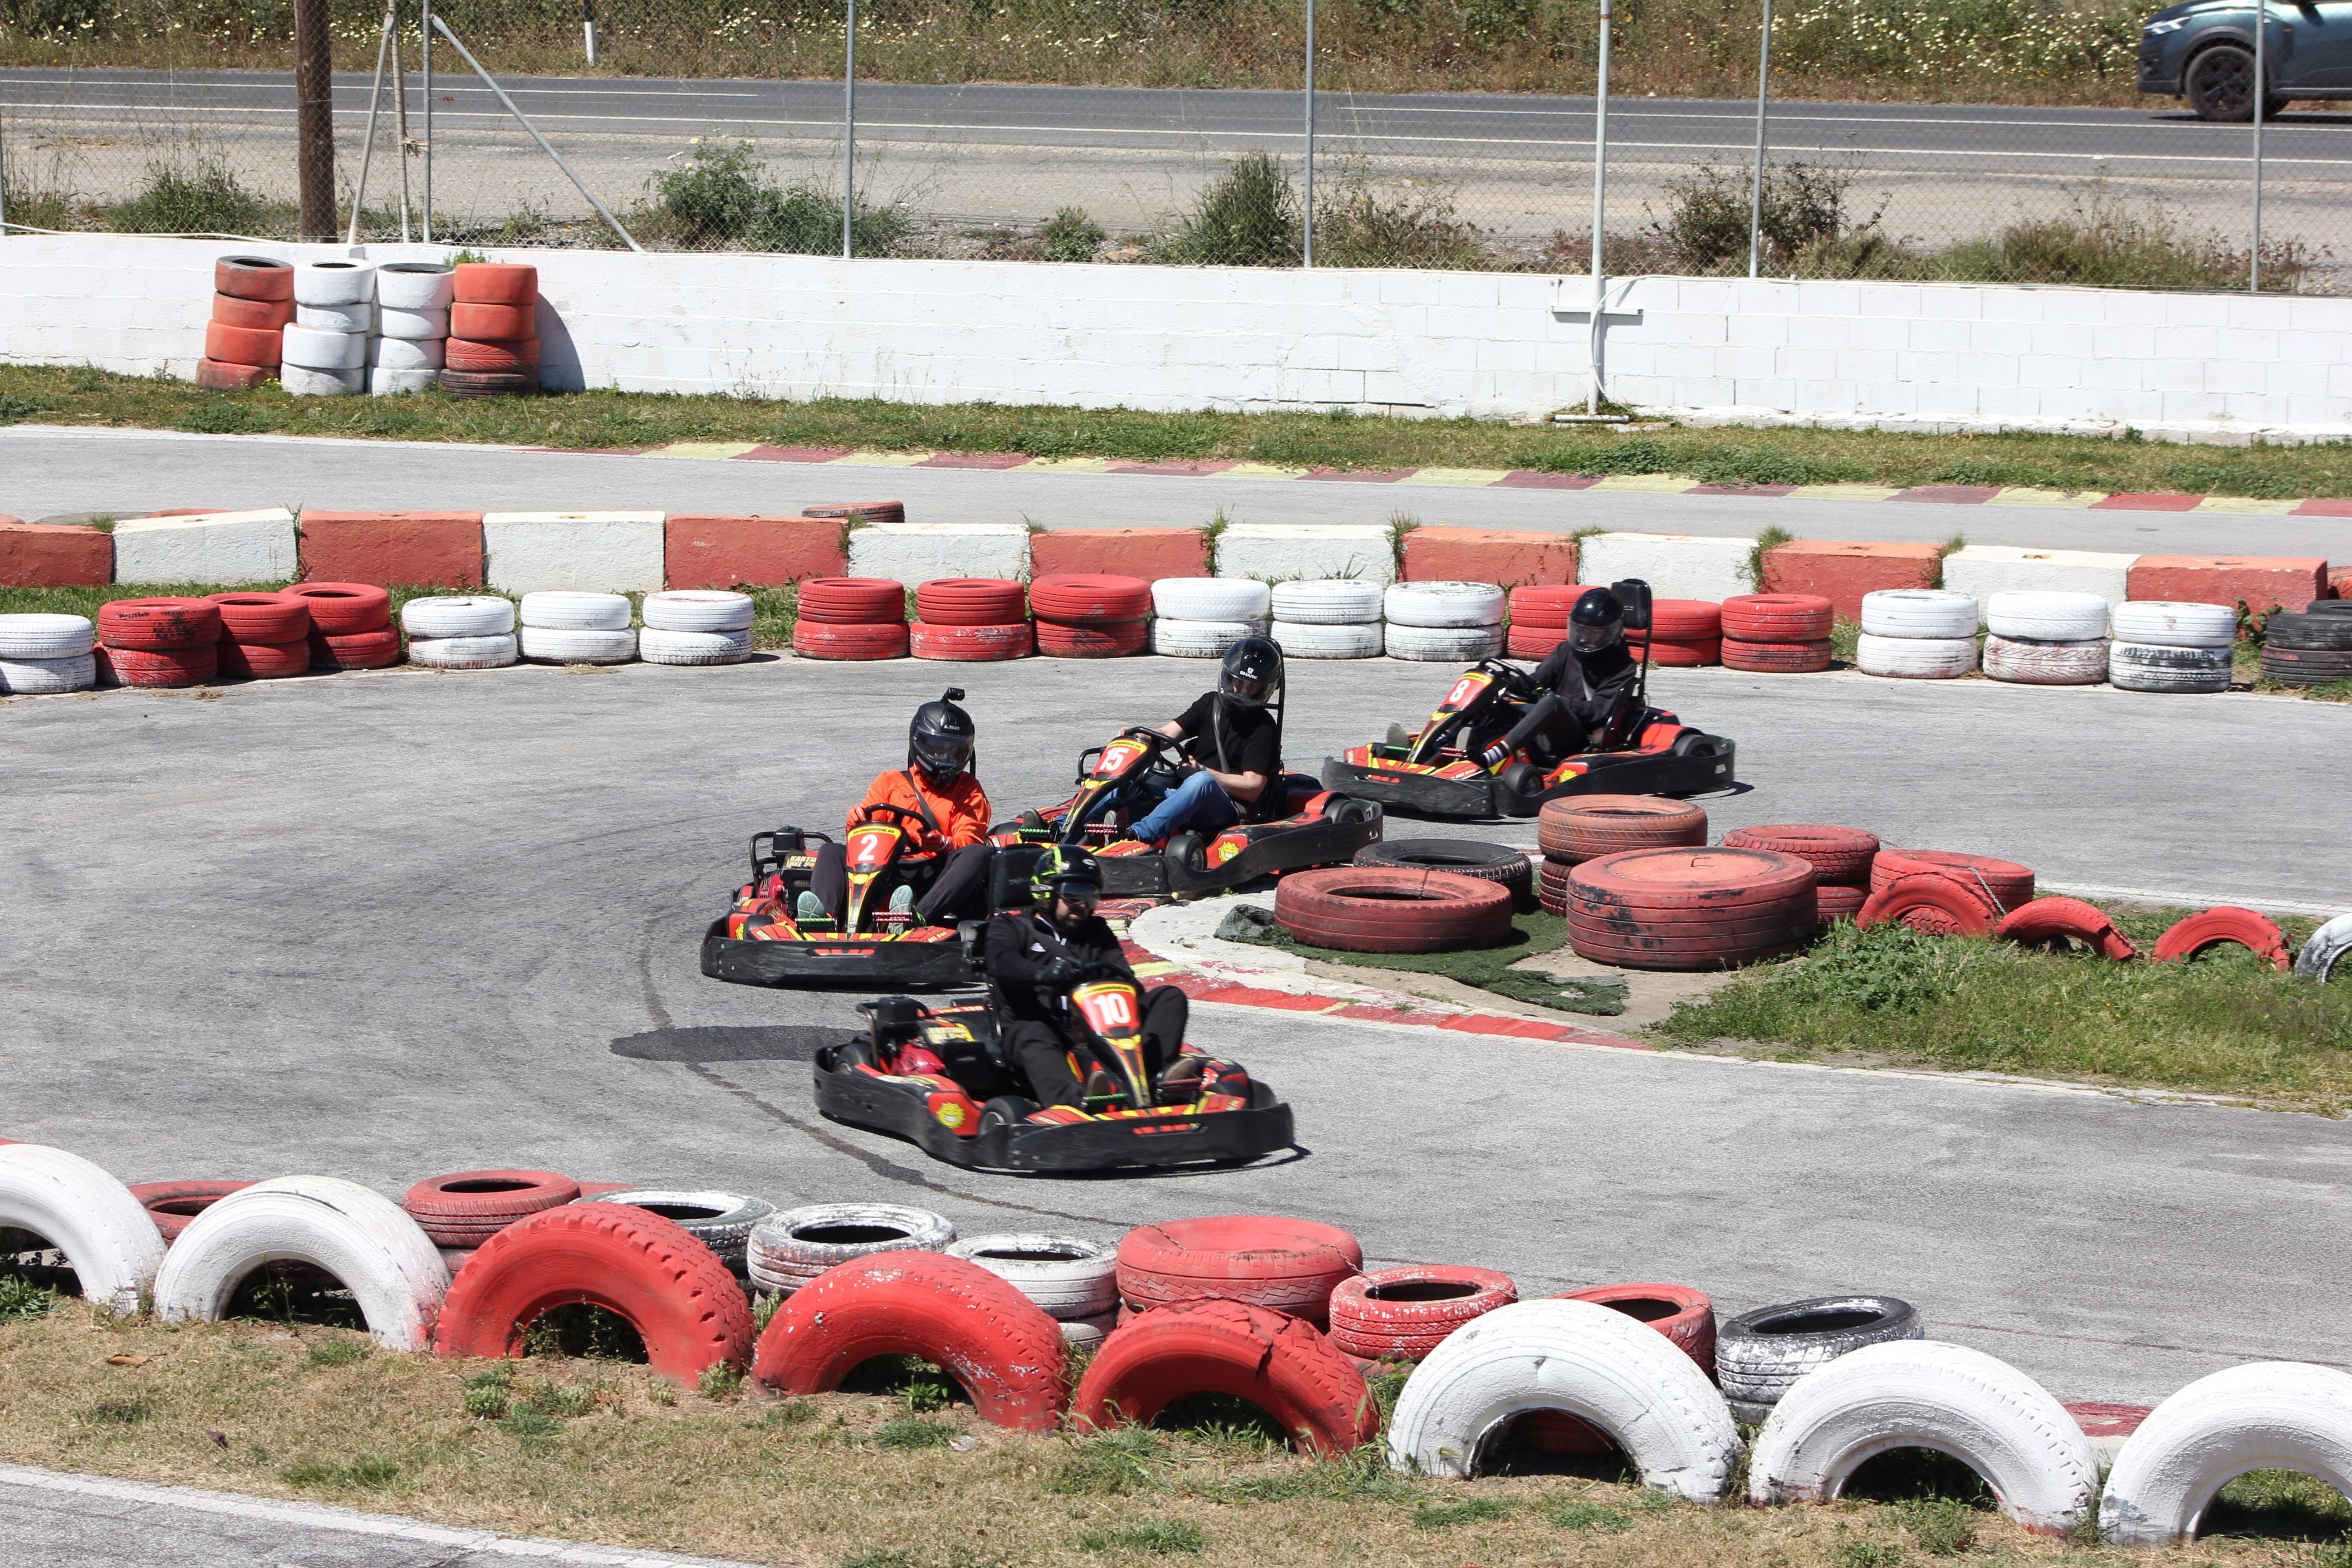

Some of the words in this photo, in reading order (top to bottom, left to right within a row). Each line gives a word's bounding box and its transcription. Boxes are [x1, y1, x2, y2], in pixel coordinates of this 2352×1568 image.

[1240, 671, 1258, 680] SHARK
[1449, 679, 1470, 702] 8
[1099, 747, 1129, 771] 15
[858, 834, 878, 861] 2
[1093, 993, 1131, 1025] 10
